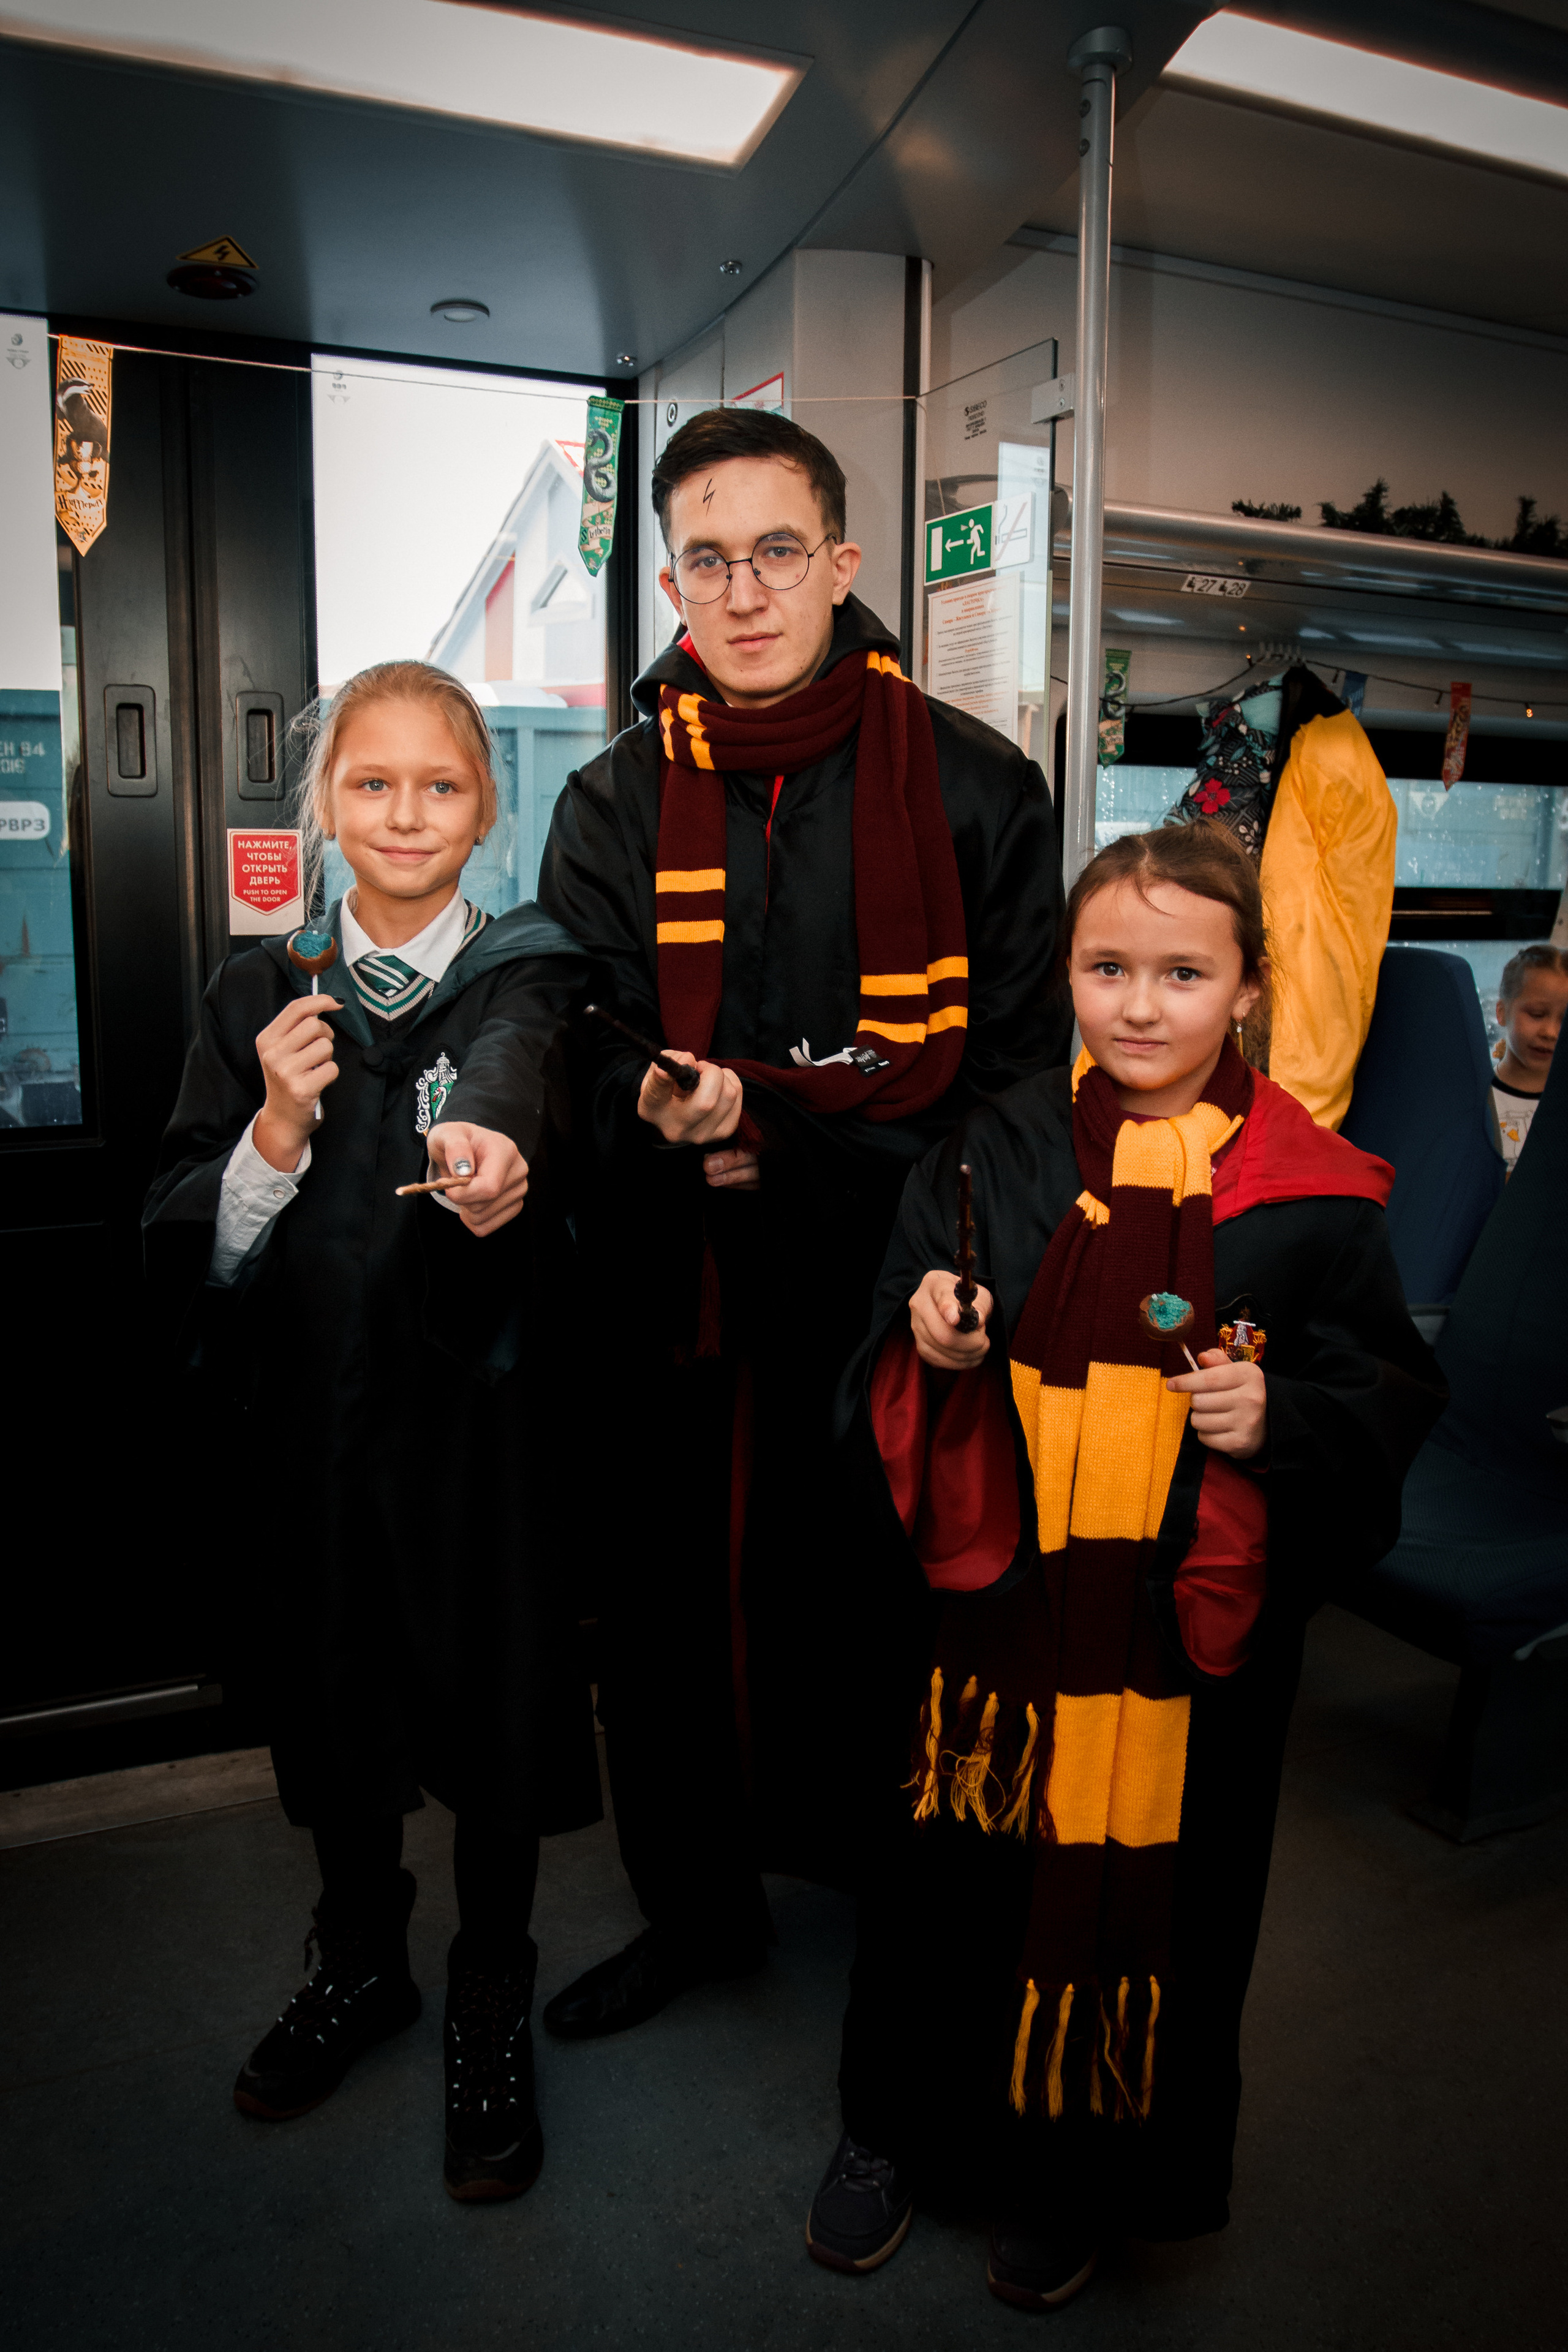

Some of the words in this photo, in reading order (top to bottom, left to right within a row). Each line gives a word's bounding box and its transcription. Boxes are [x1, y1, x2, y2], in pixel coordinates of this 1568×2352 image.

[581, 526, 611, 543] Slytherin
[1196, 578, 1218, 592] 27
[1226, 582, 1246, 596] 28
[238, 840, 292, 850] НАЖМИТЕ,
[247, 852, 282, 861] ЧТОБЫ
[241, 864, 288, 873] ОТКРЫТЬ
[249, 876, 281, 886] ДВЕРЬ
